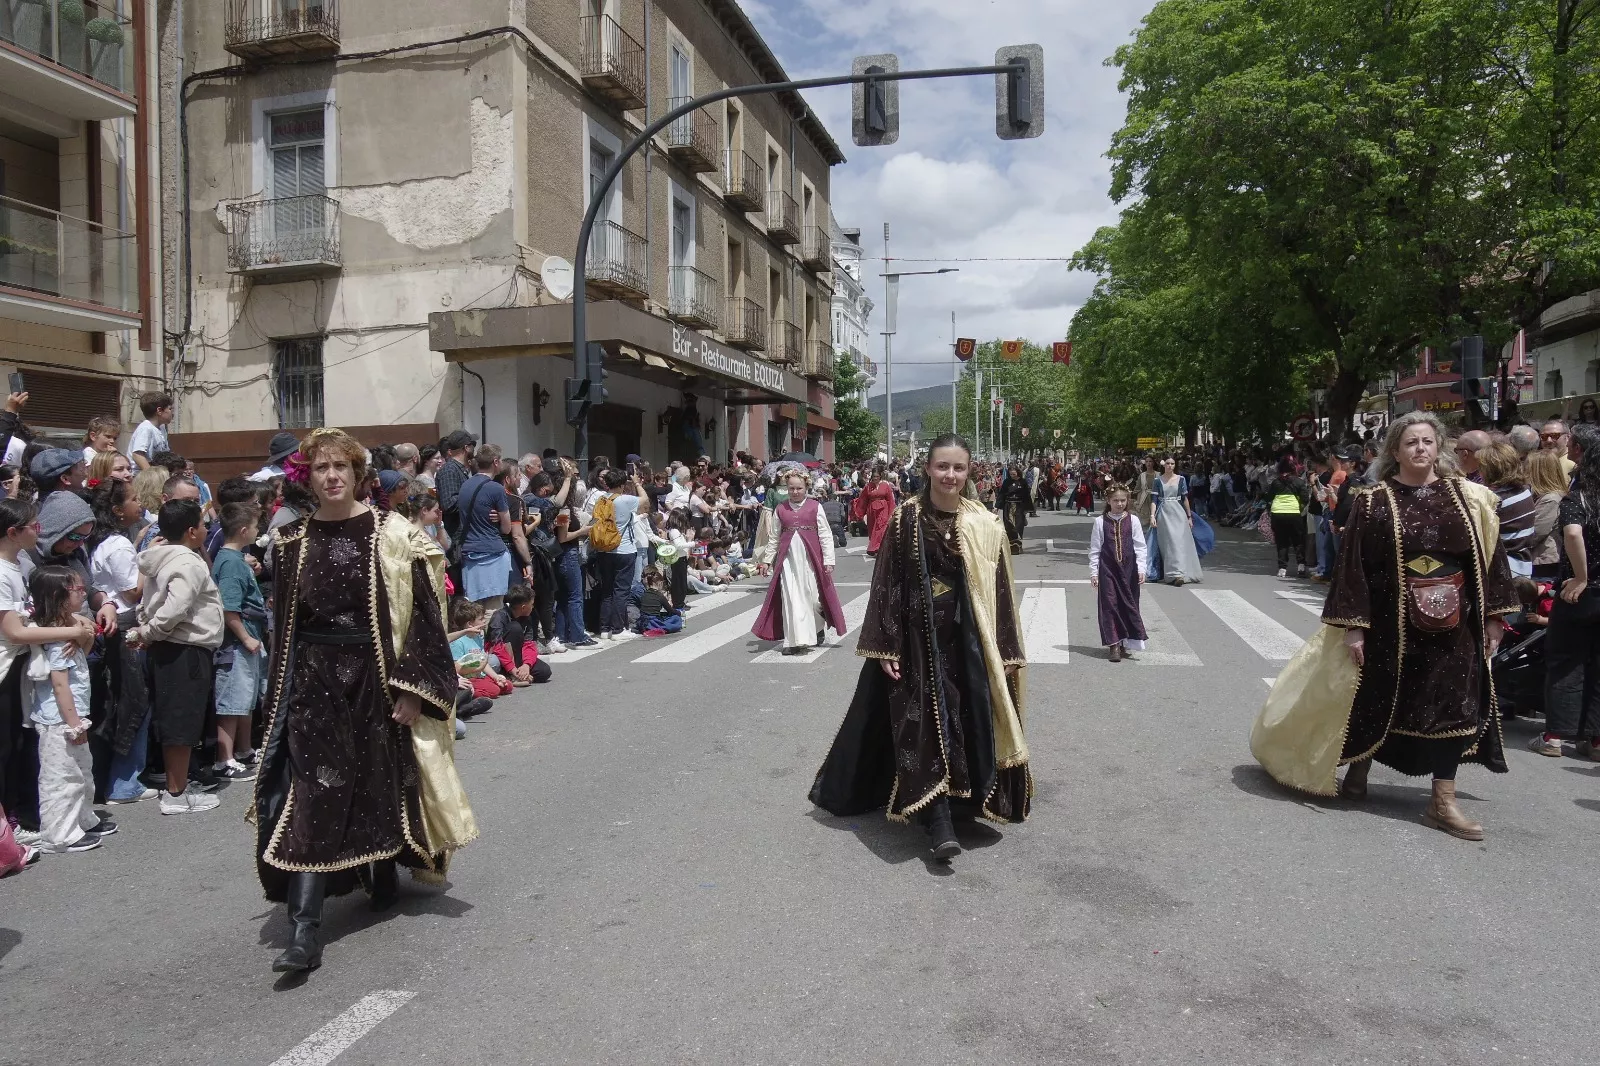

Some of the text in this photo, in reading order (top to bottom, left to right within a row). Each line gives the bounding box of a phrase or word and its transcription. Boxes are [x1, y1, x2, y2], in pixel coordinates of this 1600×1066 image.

[672, 327, 692, 357] Bar
[701, 340, 751, 380] Restaurante
[754, 361, 785, 392] EQUIZA
